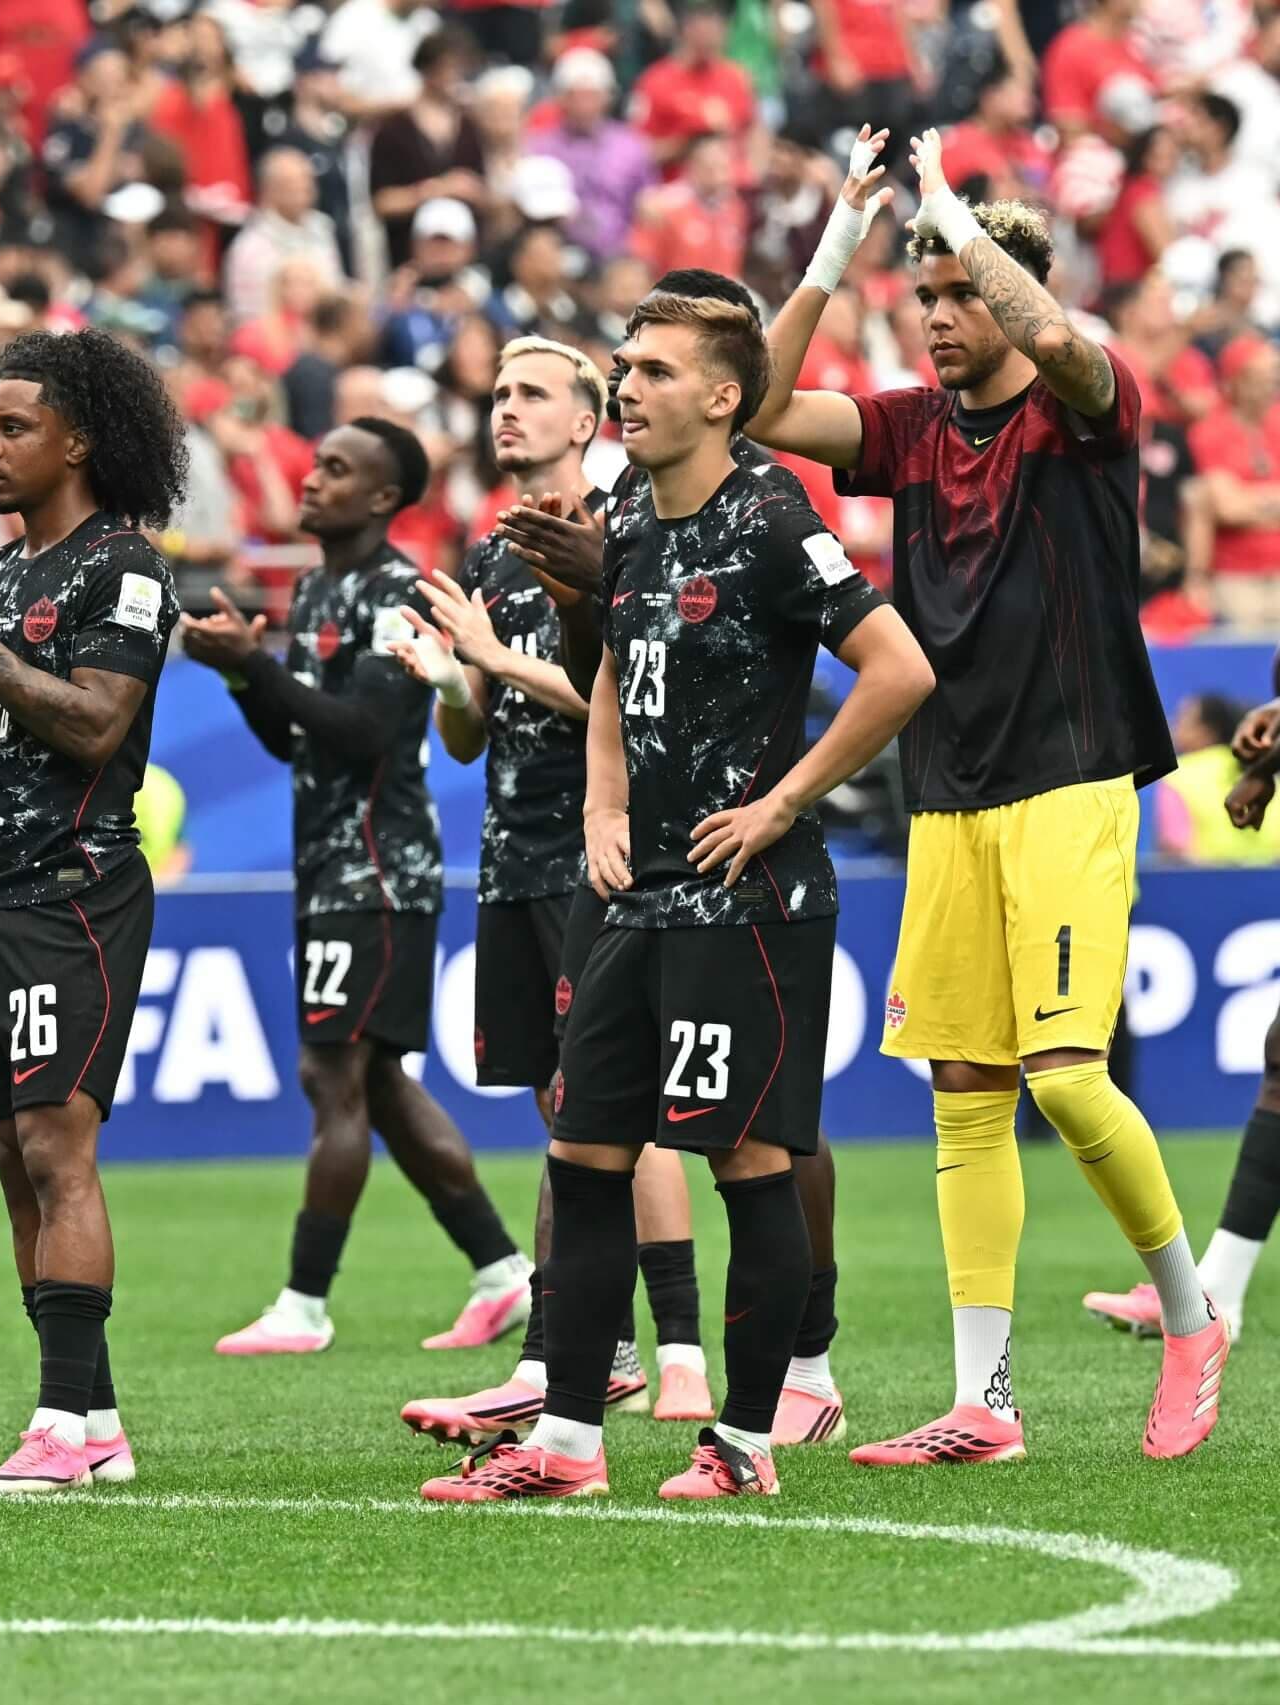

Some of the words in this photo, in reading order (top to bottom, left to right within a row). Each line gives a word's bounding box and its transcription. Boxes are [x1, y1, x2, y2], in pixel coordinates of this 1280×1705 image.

[24, 616, 56, 624] CANADA
[681, 594, 714, 604] CANADA
[625, 639, 666, 717] 23
[304, 940, 352, 1006] 22
[1054, 925, 1071, 996] 1
[8, 983, 58, 1061] 26
[663, 1019, 732, 1100] 23
